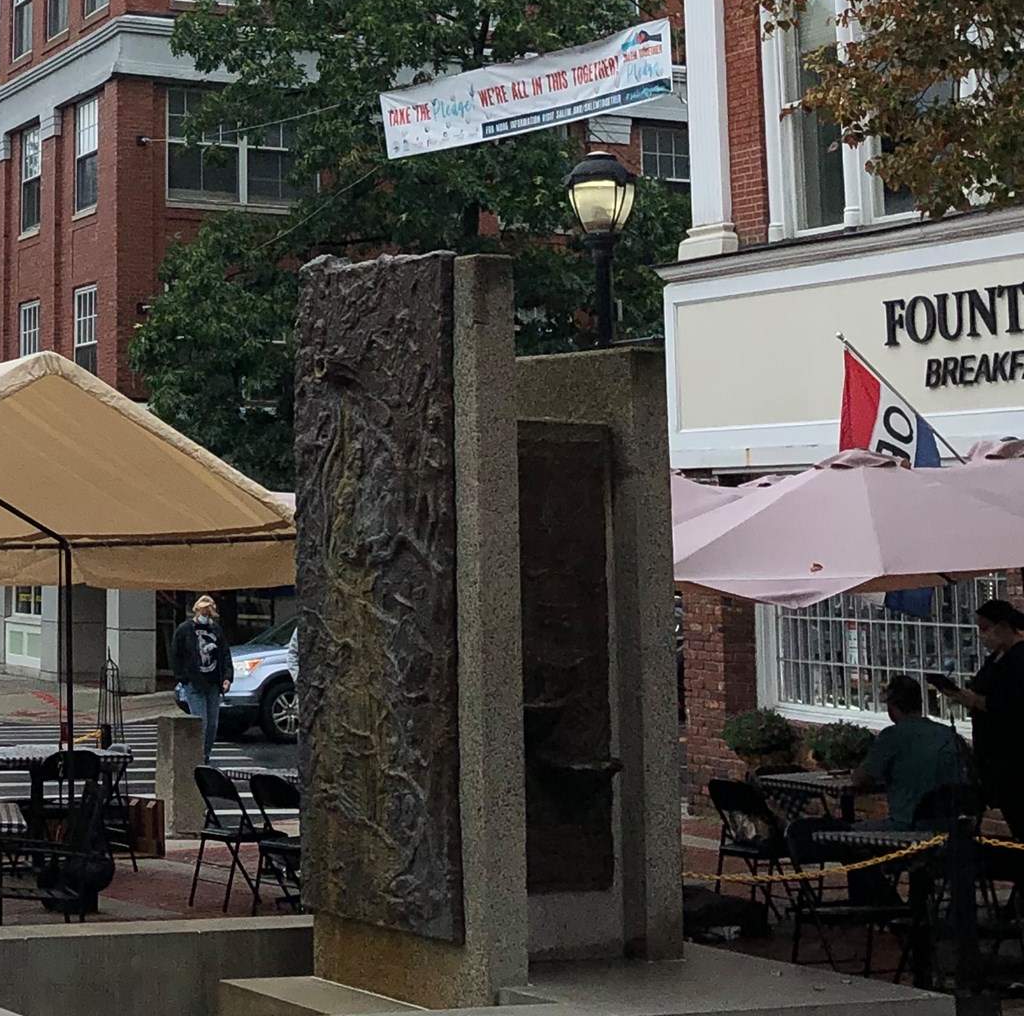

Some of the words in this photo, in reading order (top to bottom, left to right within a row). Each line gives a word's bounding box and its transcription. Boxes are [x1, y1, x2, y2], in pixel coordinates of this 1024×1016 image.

[477, 85, 508, 107] WE'RE
[511, 82, 529, 100] ALL
[532, 77, 542, 96] IN
[546, 71, 569, 92] THIS
[388, 107, 411, 127] TAKE
[415, 103, 431, 122] THE
[925, 349, 1024, 388] BREAKF
